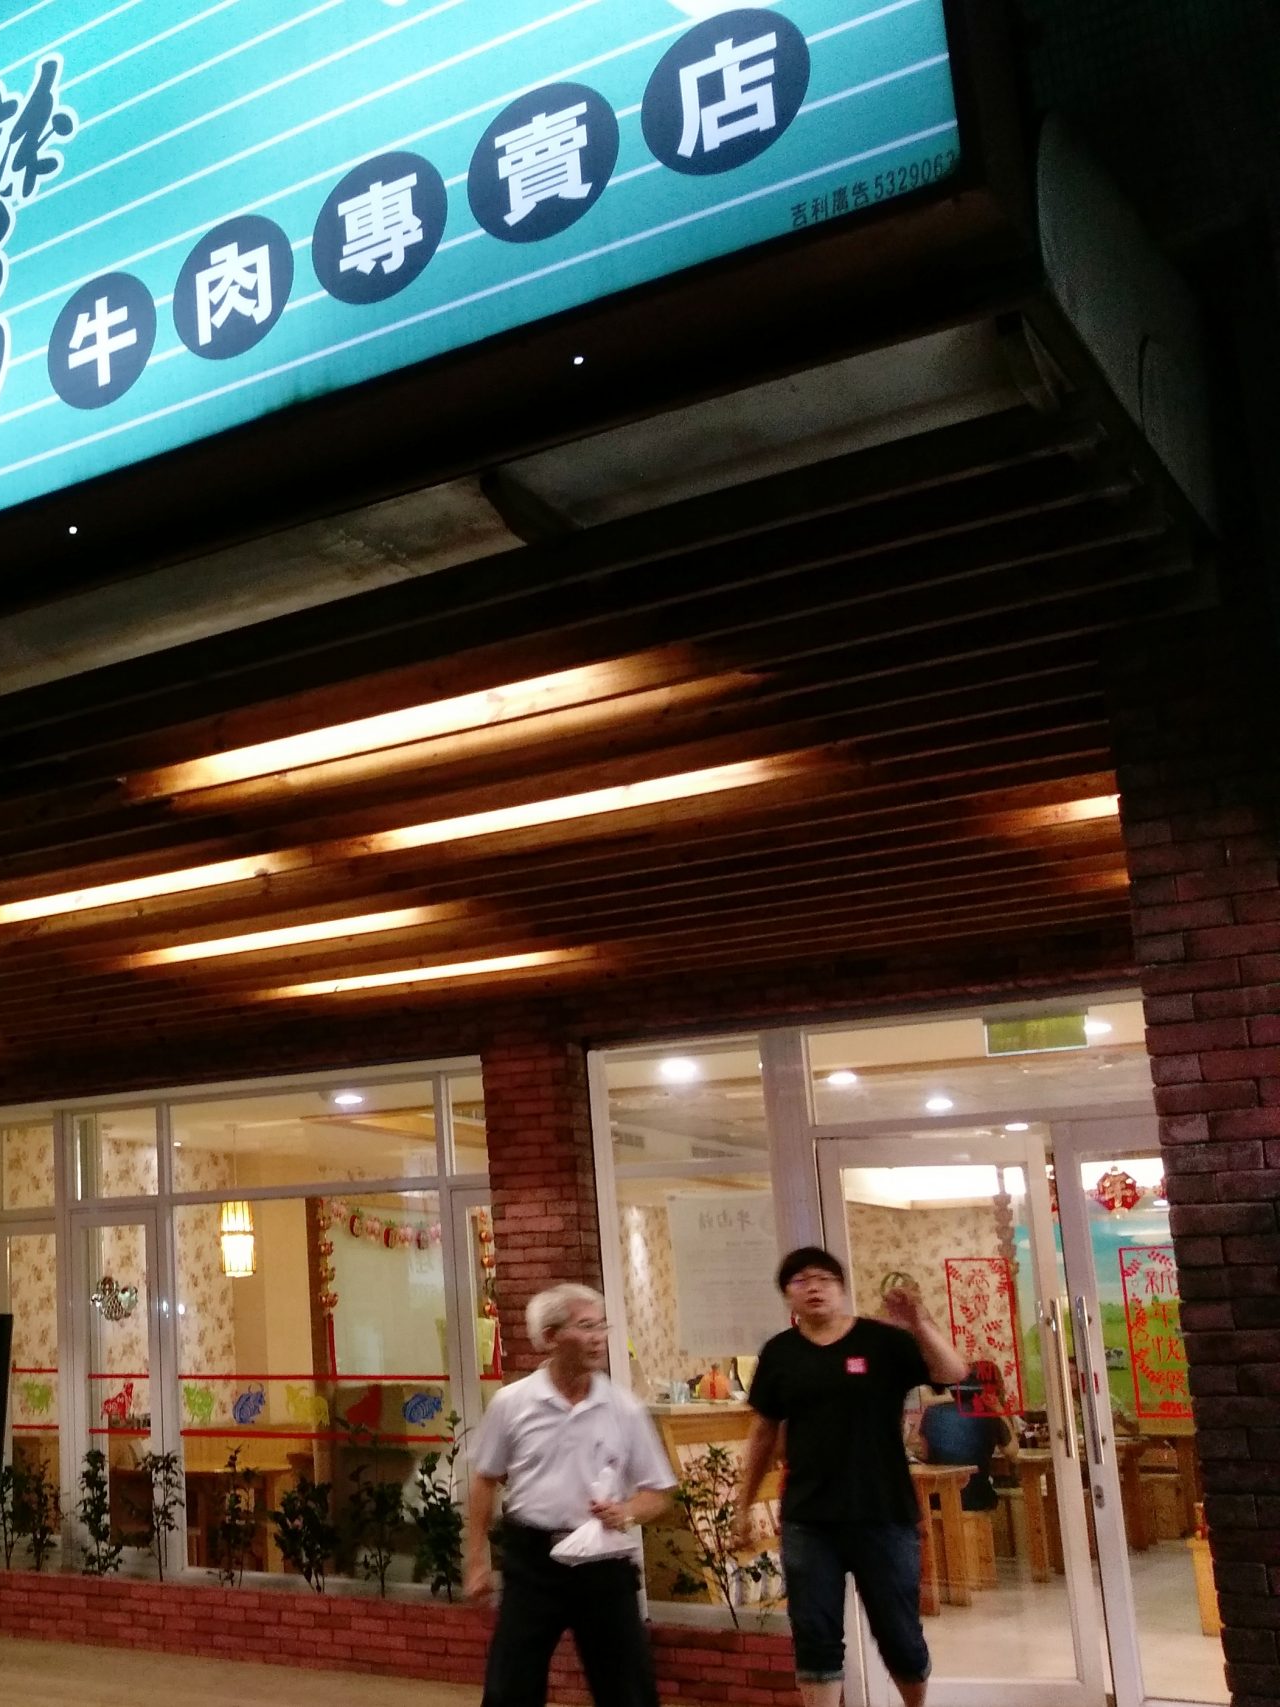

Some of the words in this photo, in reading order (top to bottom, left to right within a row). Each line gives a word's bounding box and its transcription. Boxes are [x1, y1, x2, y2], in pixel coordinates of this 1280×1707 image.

[60, 22, 788, 395] 牛肉專賣店
